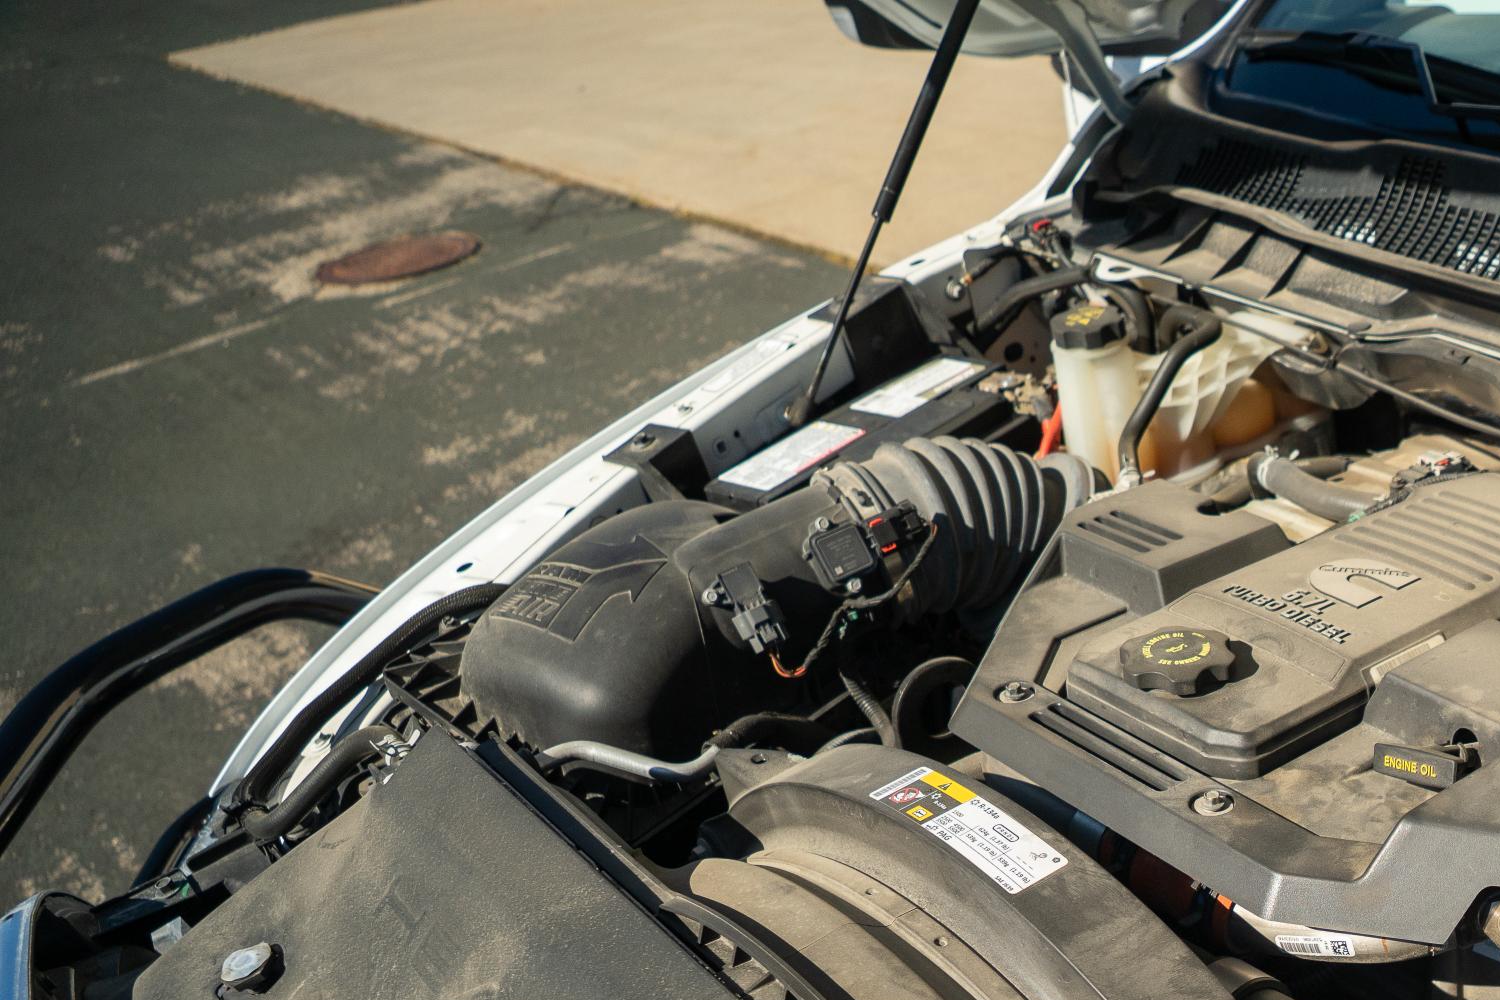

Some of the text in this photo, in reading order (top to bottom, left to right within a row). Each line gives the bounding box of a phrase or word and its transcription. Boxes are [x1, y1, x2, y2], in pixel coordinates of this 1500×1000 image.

[1383, 754, 1438, 778] ENGINE OIL
[976, 803, 1002, 819] R-134a
[935, 830, 952, 841] PAG
